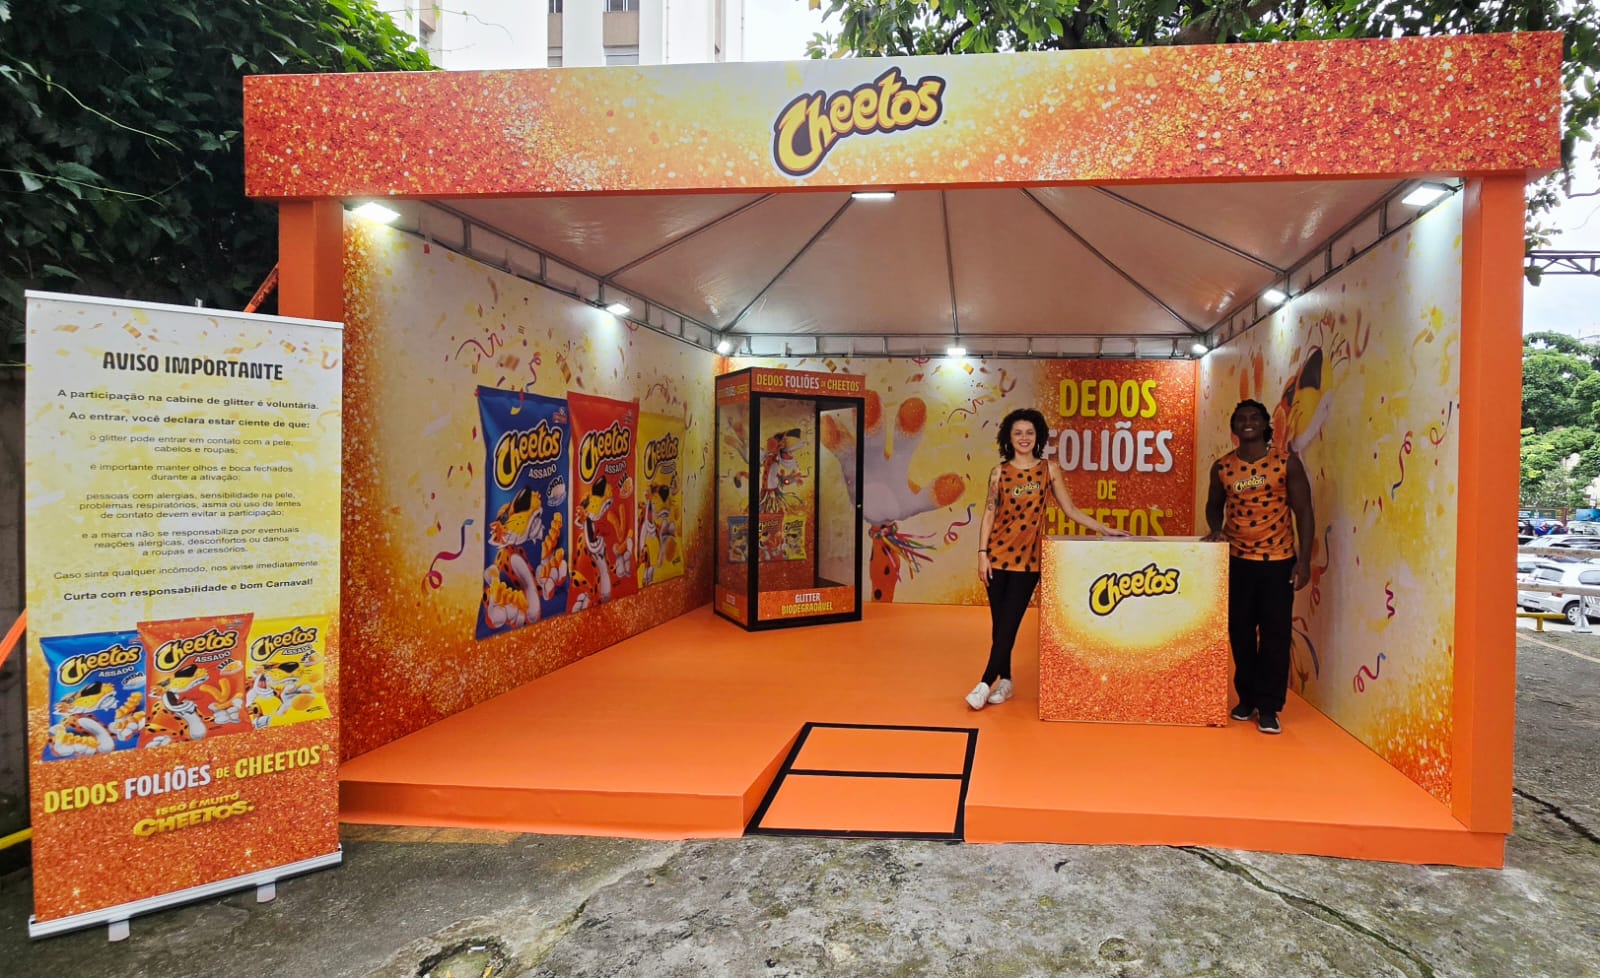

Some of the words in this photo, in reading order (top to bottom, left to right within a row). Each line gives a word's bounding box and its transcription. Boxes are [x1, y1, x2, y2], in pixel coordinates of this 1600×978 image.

[774, 66, 946, 176] Cheetos
[103, 351, 159, 372] AVISO
[165, 356, 283, 381] IMPORTANTE
[757, 374, 783, 386] DEDOS
[785, 374, 820, 390] FOLIÕES
[827, 380, 860, 391] CHEETOS
[58, 389, 67, 397] A
[70, 389, 145, 402] participação
[148, 394, 163, 402] na
[166, 395, 203, 404] cabine
[207, 397, 220, 405] de
[223, 397, 254, 408] glitter
[266, 400, 319, 410] voluntária.
[1059, 379, 1157, 418] DEDOS
[69, 412, 86, 420] Ao
[90, 413, 129, 423] entrar,
[132, 414, 160, 423] você
[163, 415, 205, 424] declara
[208, 418, 236, 426] estar
[239, 419, 270, 427] ciente
[273, 420, 285, 428] de
[289, 421, 310, 430] que:
[99, 434, 127, 443] glitter
[130, 435, 155, 444] pode
[207, 437, 241, 445] contato
[1042, 421, 1174, 472] FOLIÕES
[154, 445, 192, 453] cabelos
[494, 419, 564, 490] Cheetos
[579, 420, 631, 483] Cheetos
[643, 432, 680, 480] Cheetos
[99, 463, 154, 474] importante
[254, 465, 293, 473] fechados
[151, 473, 188, 481] durante
[528, 466, 557, 479] ASSADO
[1097, 480, 1117, 500] DE
[1234, 476, 1265, 493] Cheetos
[86, 492, 129, 501] pessoas
[200, 491, 259, 500] sensibilidade
[79, 501, 133, 511] problemas
[100, 511, 113, 519] de
[116, 511, 153, 519] contato
[156, 510, 189, 518] devem
[192, 510, 217, 518] evitar
[136, 529, 155, 538] não
[171, 528, 239, 539] responsabiliza
[241, 527, 255, 536] por
[258, 526, 299, 535] eventuais
[94, 539, 135, 550] reações
[188, 536, 247, 546] desconfortos
[264, 535, 289, 543] danos
[151, 548, 185, 558] roupas
[54, 571, 81, 580] Caso
[84, 570, 108, 579] sinta
[111, 568, 156, 578] qualquer
[158, 564, 207, 576] incômodo,
[230, 562, 254, 571] avise
[63, 591, 97, 601] Curta
[101, 590, 127, 599] com
[130, 582, 229, 598] responsabilidade
[240, 580, 263, 590] bom
[266, 578, 313, 588] Carnaval!
[795, 593, 820, 604] GLITTER
[1089, 563, 1180, 616] Cheetos
[154, 628, 239, 672] Cheetos
[251, 626, 318, 662] Cheetos
[58, 644, 141, 686] Cheetos
[195, 651, 231, 663] ASSADO
[98, 665, 135, 678] ASSADO
[44, 781, 119, 813] DEDOS
[124, 765, 211, 800] FOLIÕES
[215, 766, 230, 779] DE
[156, 802, 188, 816] ISSO
[199, 791, 240, 807] MUITO
